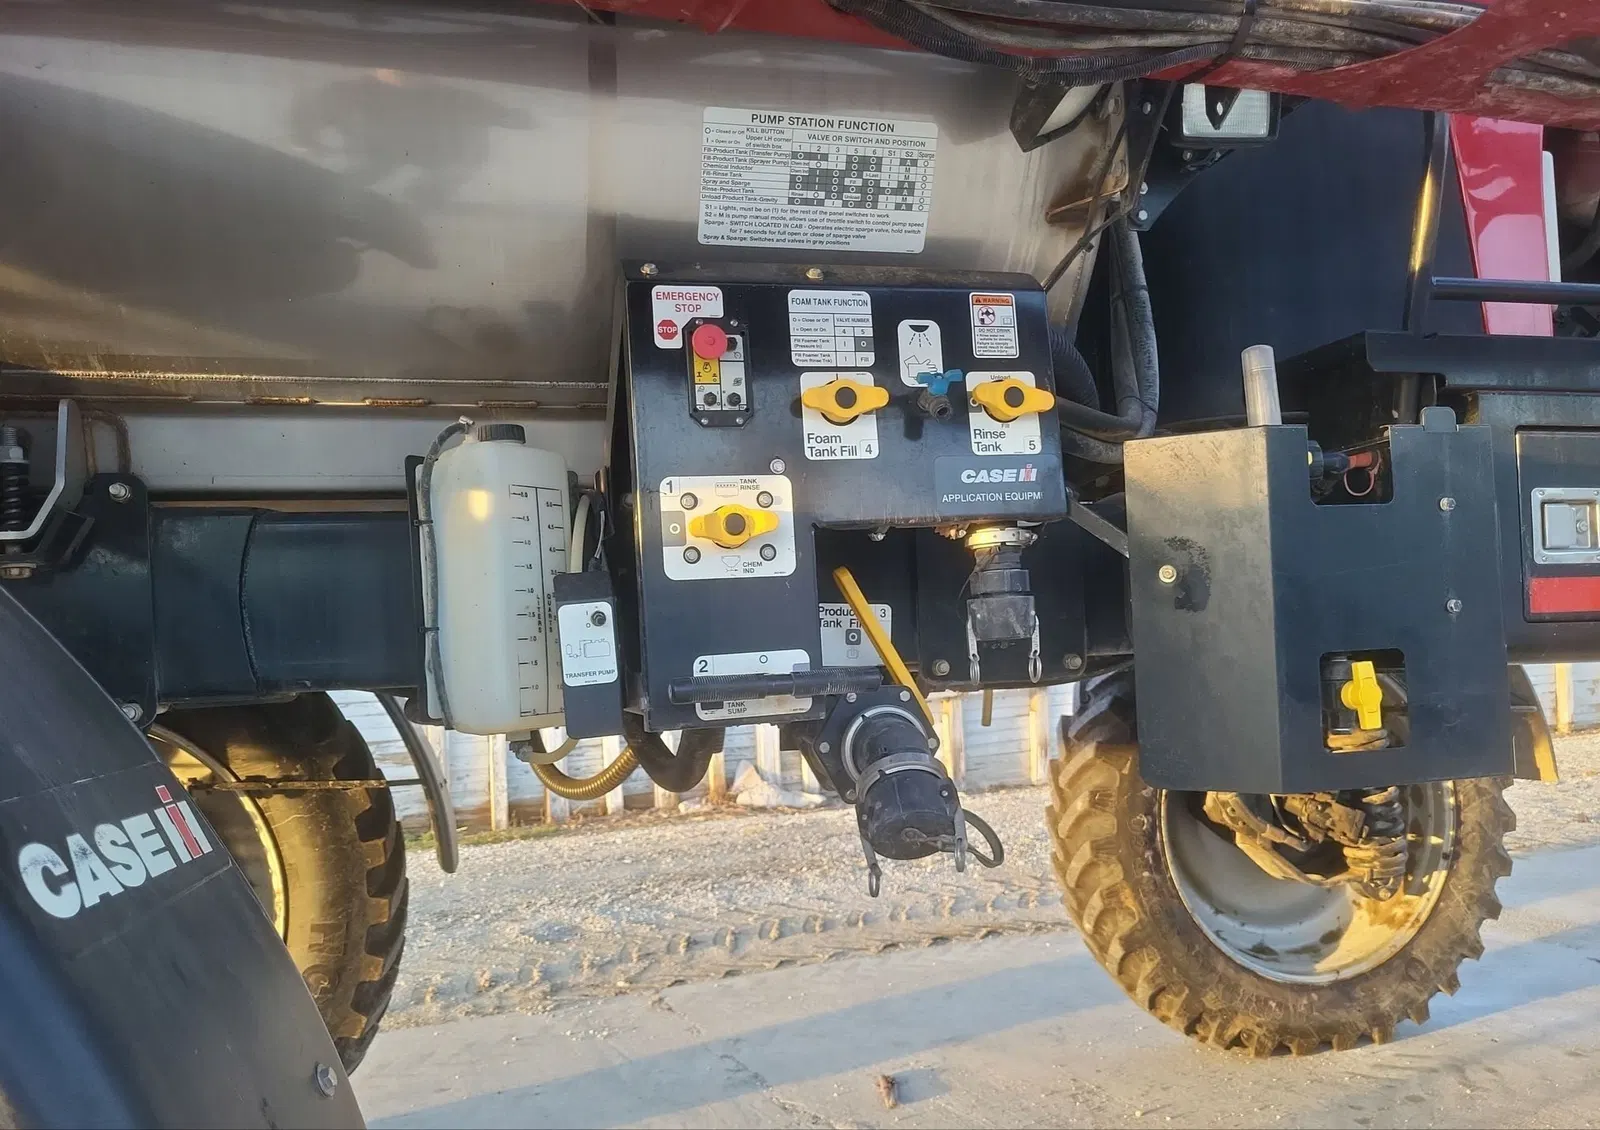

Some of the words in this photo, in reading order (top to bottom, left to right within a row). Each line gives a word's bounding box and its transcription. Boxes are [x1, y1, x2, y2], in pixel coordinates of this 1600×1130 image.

[752, 114, 785, 124] PUMP
[788, 116, 834, 129] STATION
[838, 120, 895, 132] FUNCTION
[808, 134, 830, 142] VALVE
[844, 136, 872, 144] SWITCH
[892, 140, 926, 148] POSITION
[703, 147, 734, 155] Fill-Product
[918, 152, 934, 160] Sparge
[748, 158, 774, 166] (Sprayer
[744, 196, 778, 204] Tank-Gravity
[656, 292, 720, 302] EMERGENCY
[792, 297, 812, 306] FOAM
[812, 298, 832, 306] TANK
[834, 298, 868, 307] FUNCTION
[674, 304, 702, 313] STOP
[807, 432, 842, 444] Foam
[973, 428, 1006, 440] Rinse
[865, 444, 872, 454] 4
[974, 442, 1002, 452] Tank
[1028, 440, 1036, 450] 5
[807, 446, 838, 458] Tank
[840, 446, 858, 456] Fill
[960, 468, 1018, 484] CASE
[666, 480, 673, 494] 1
[942, 492, 1002, 503] APPLICATION
[1004, 492, 1043, 501] EQUIPM
[818, 606, 856, 616] Produc
[880, 608, 886, 618] 3
[850, 618, 862, 628] Fi
[698, 660, 709, 673] 2
[566, 670, 597, 679] TRANSFER
[18, 812, 178, 919] CASE
